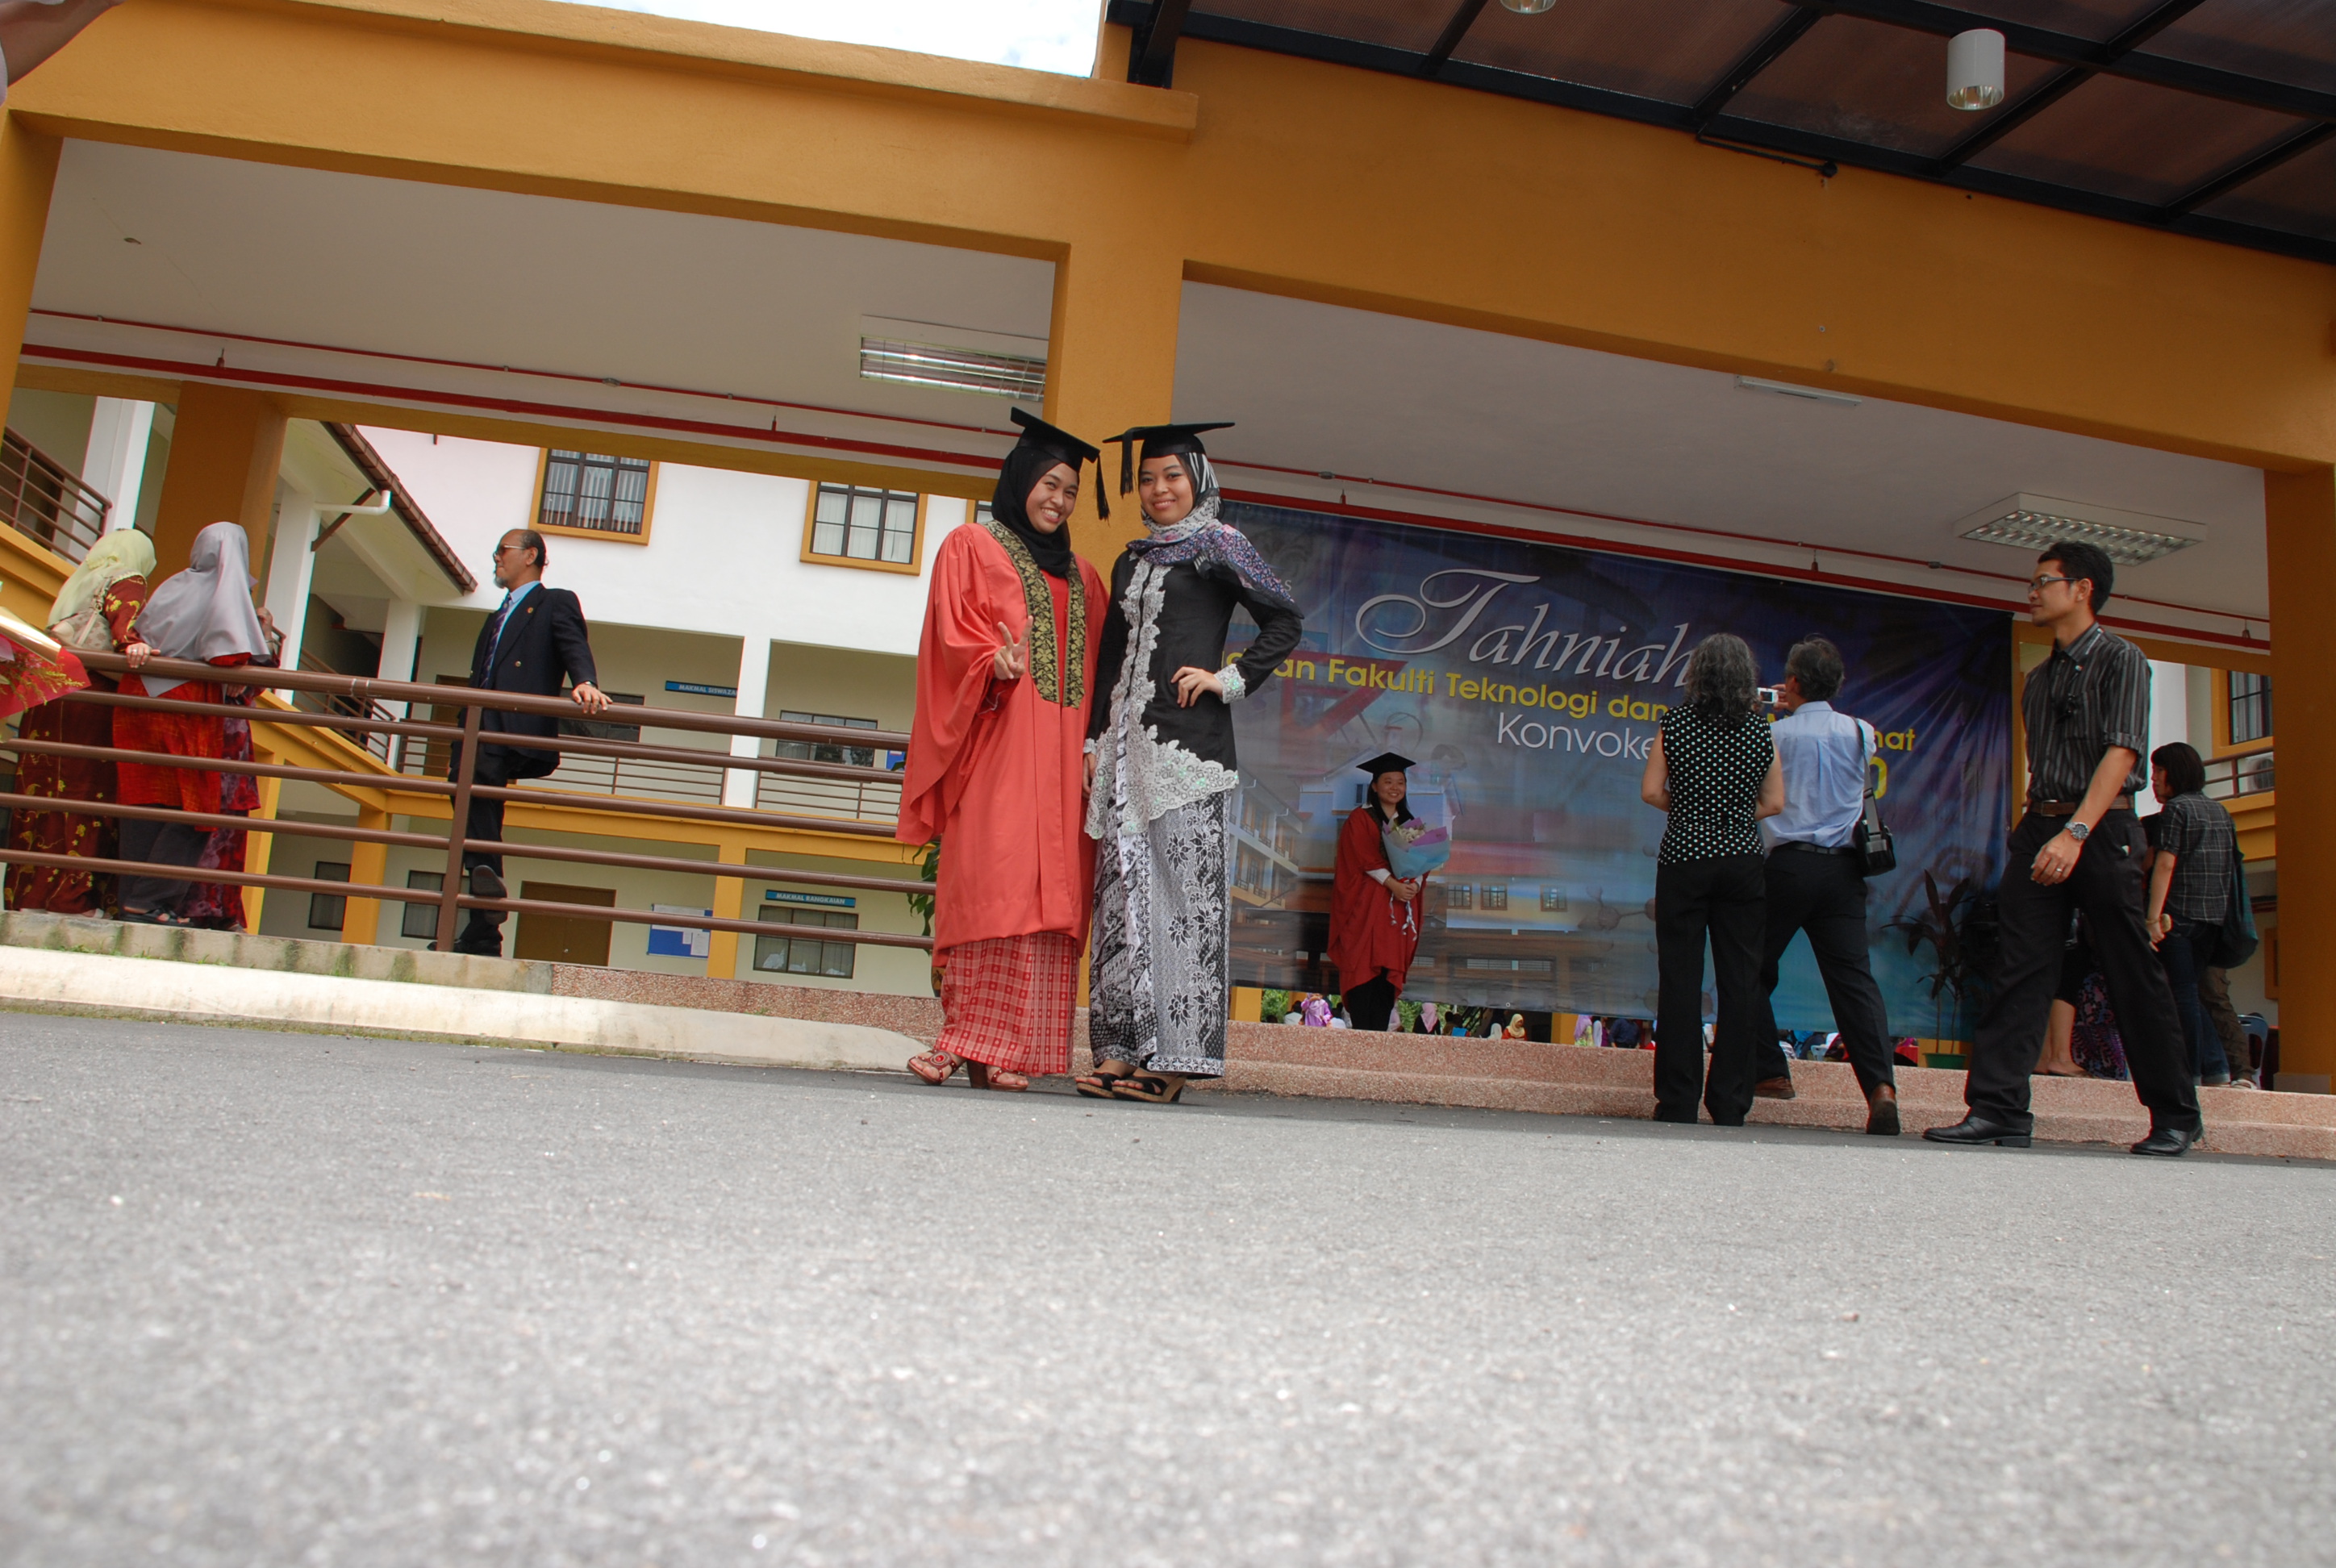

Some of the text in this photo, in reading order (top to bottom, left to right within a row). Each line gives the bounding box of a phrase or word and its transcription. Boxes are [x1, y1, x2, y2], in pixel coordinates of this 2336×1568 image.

[1355, 569, 1693, 688] Tahniah
[678, 684, 736, 695] MAKMAL SISWAZA
[1328, 657, 1436, 695] Fakulti
[1445, 672, 1599, 719] Teknologi
[1608, 694, 1670, 722] dan
[1497, 711, 1656, 761] Konvoke
[775, 892, 846, 904] MAKMAL RANGKAIAN
